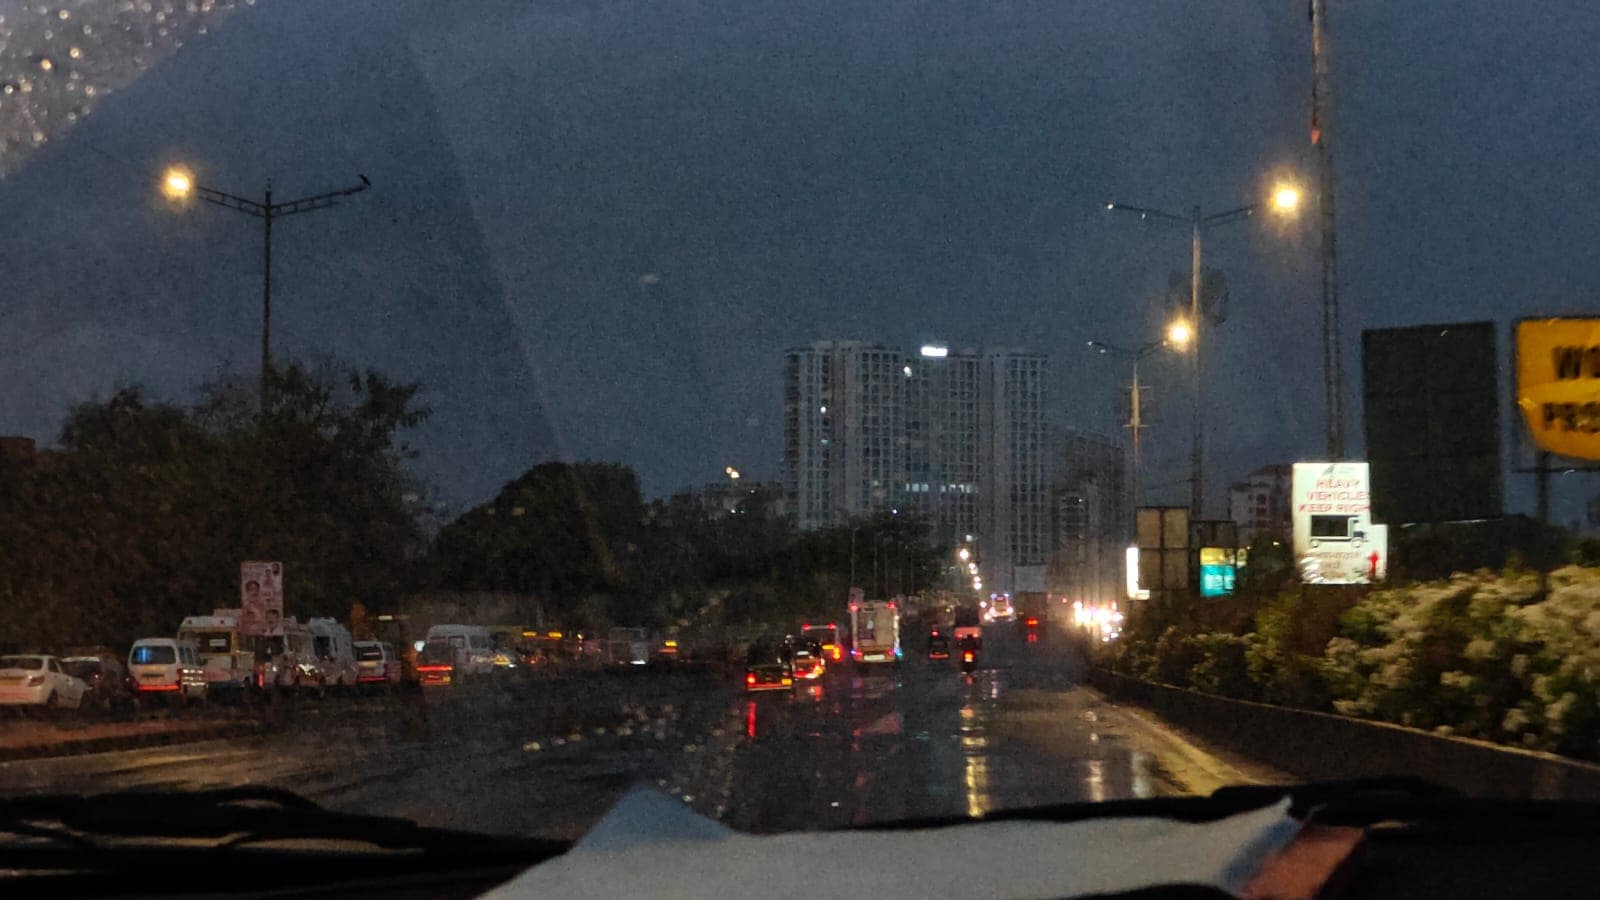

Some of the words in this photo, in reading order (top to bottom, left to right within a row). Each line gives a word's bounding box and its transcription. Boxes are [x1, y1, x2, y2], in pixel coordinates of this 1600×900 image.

[1542, 402, 1600, 433] PRO
[1316, 479, 1360, 489] HEAVY
[1306, 491, 1369, 501] VEHICLE
[1298, 503, 1332, 513] KEEP
[1336, 503, 1371, 513] RIGH
